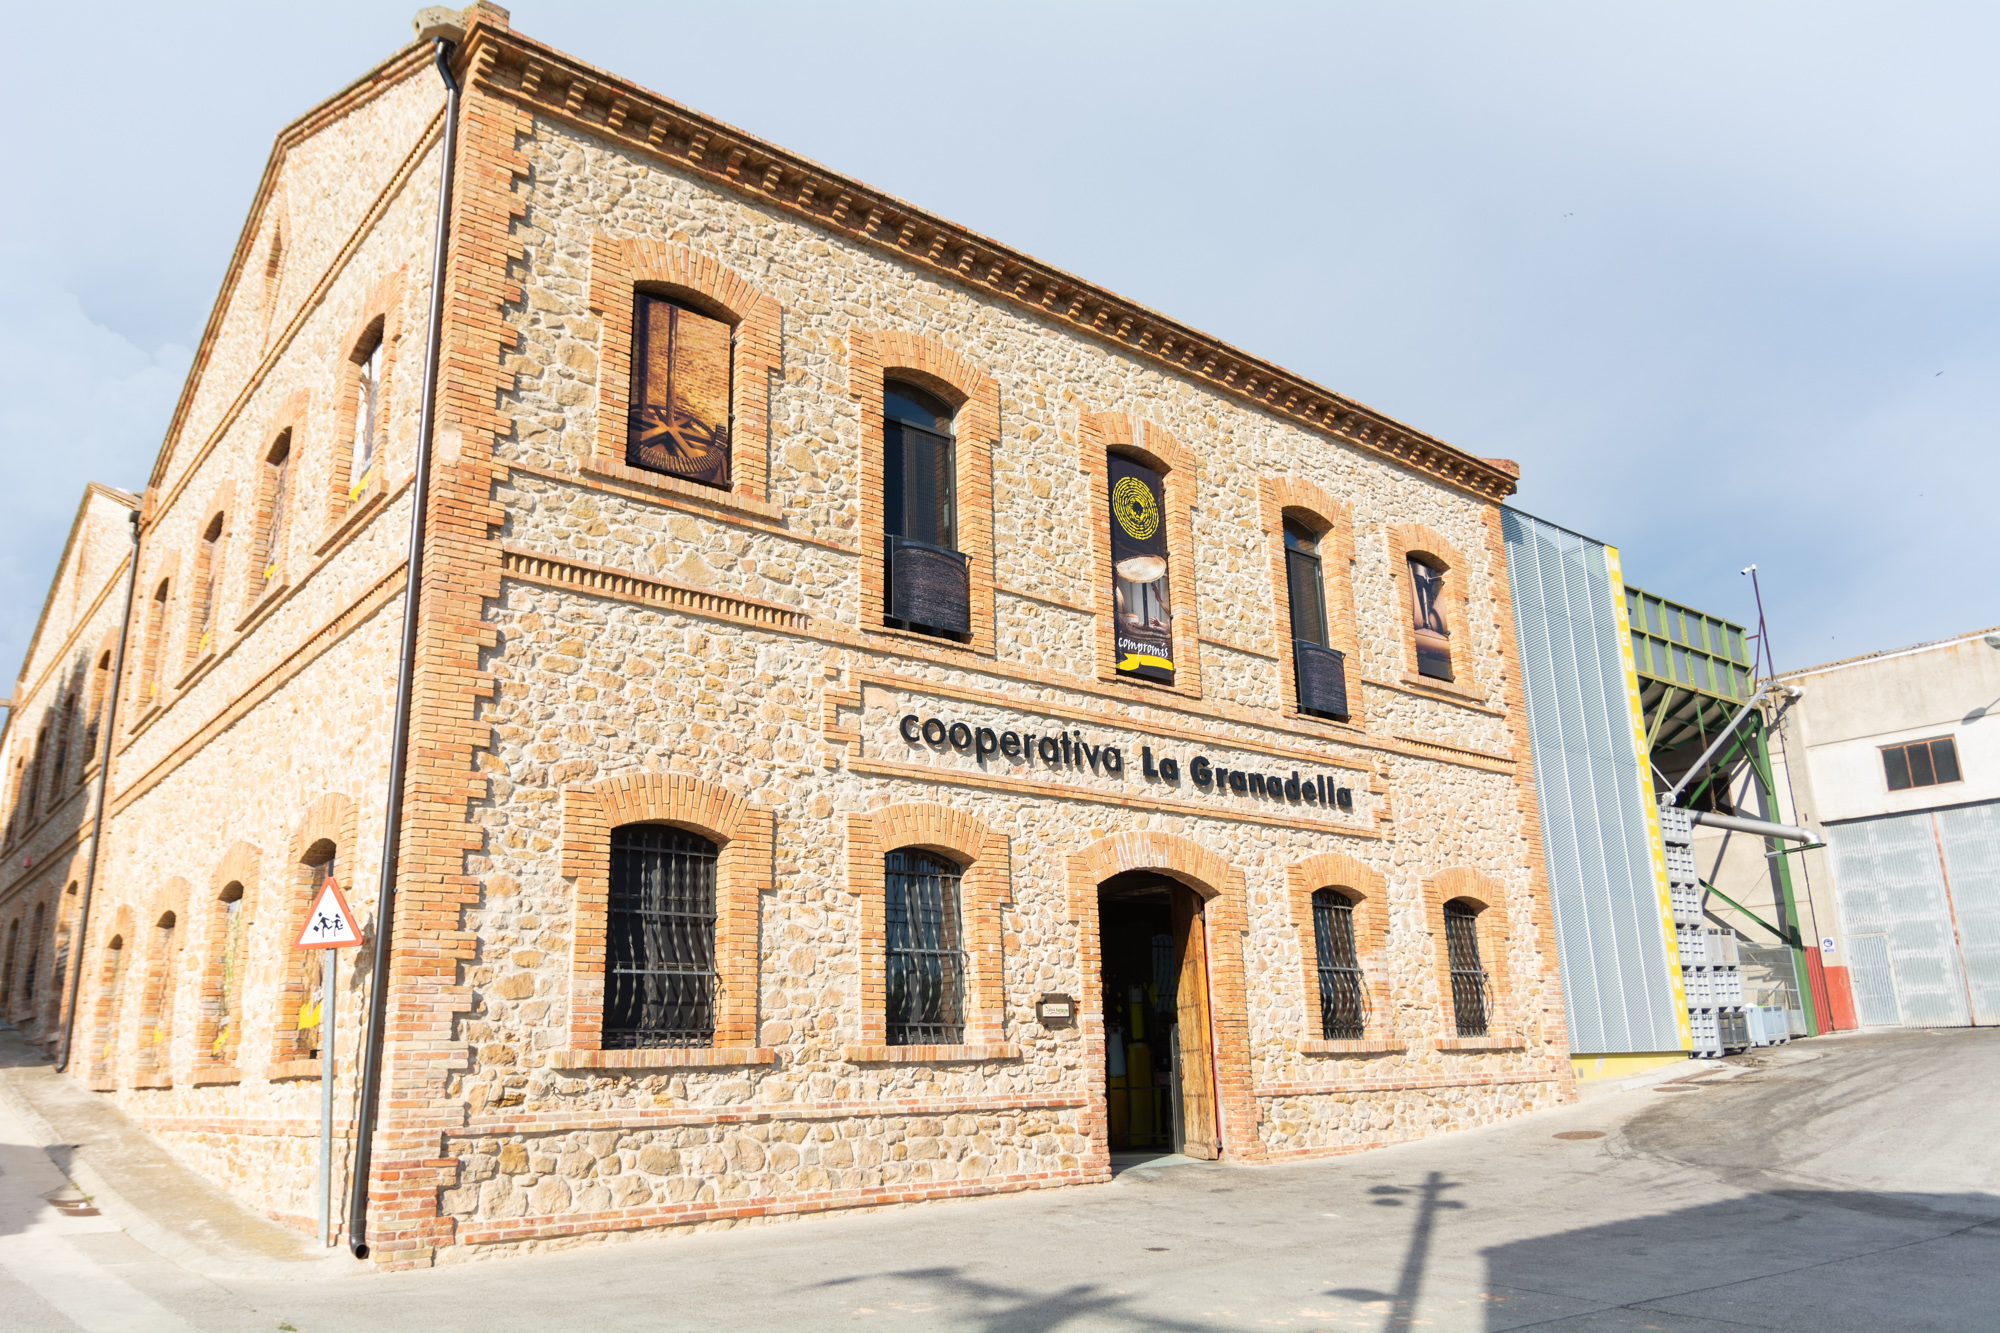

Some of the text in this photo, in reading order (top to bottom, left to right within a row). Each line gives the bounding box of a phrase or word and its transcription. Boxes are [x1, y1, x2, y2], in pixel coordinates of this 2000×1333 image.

[1118, 637, 1169, 660] compromís
[900, 714, 1353, 809] cooperativa La Granadella
[1608, 556, 1633, 671] MUSEU
[1632, 713, 1652, 809] L'OLI
[1651, 836, 1689, 1038] CATALUNYA
